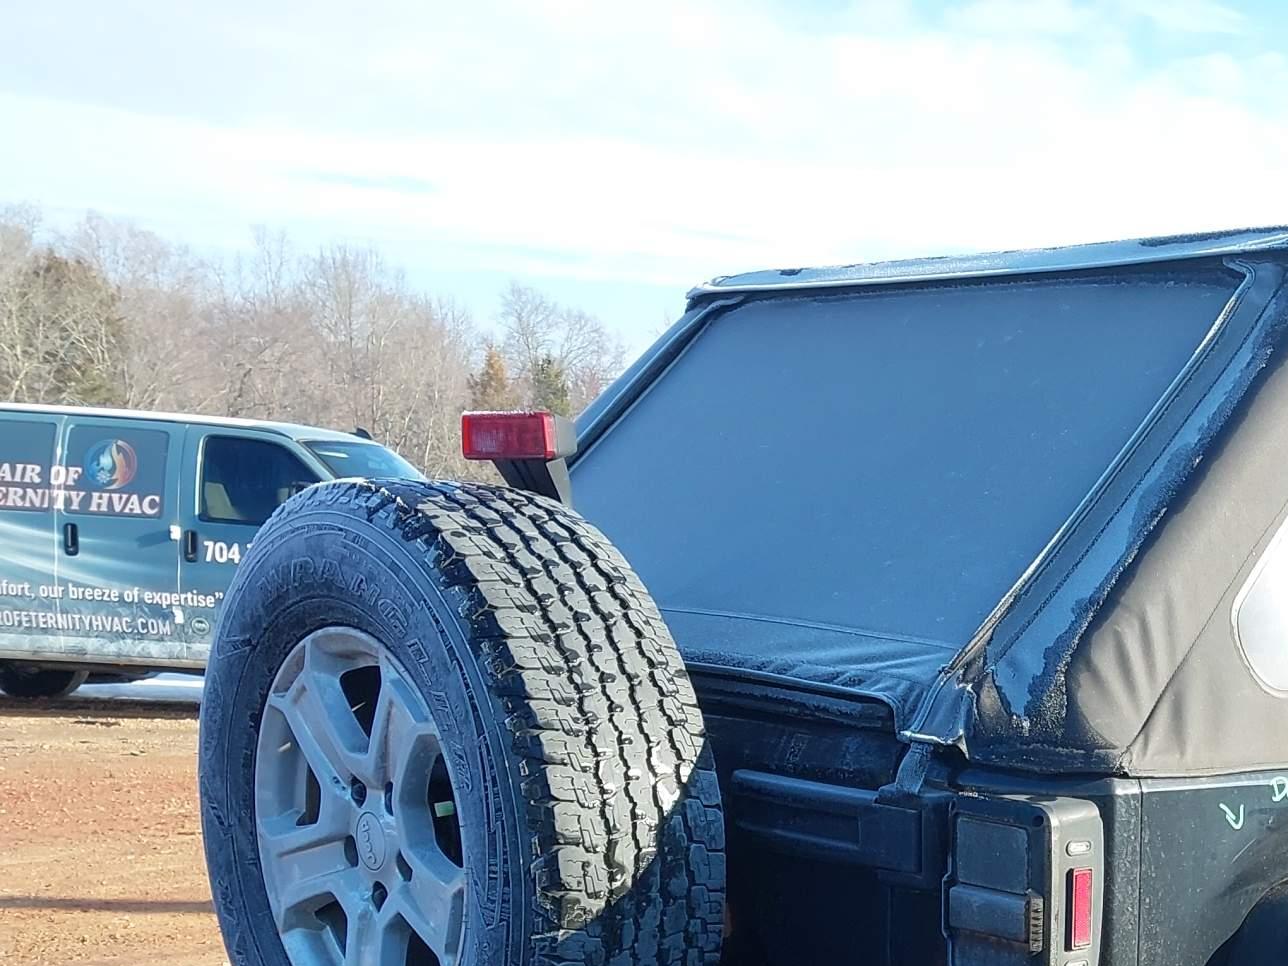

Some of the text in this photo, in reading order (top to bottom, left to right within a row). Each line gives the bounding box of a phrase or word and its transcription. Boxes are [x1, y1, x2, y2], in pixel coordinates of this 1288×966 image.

[0, 463, 82, 486] AIR OF
[89, 491, 160, 515] HVAC
[203, 541, 240, 564] 704
[0, 580, 35, 597] fort,
[39, 585, 64, 598] our
[69, 583, 119, 602] breeze
[123, 587, 141, 604] of
